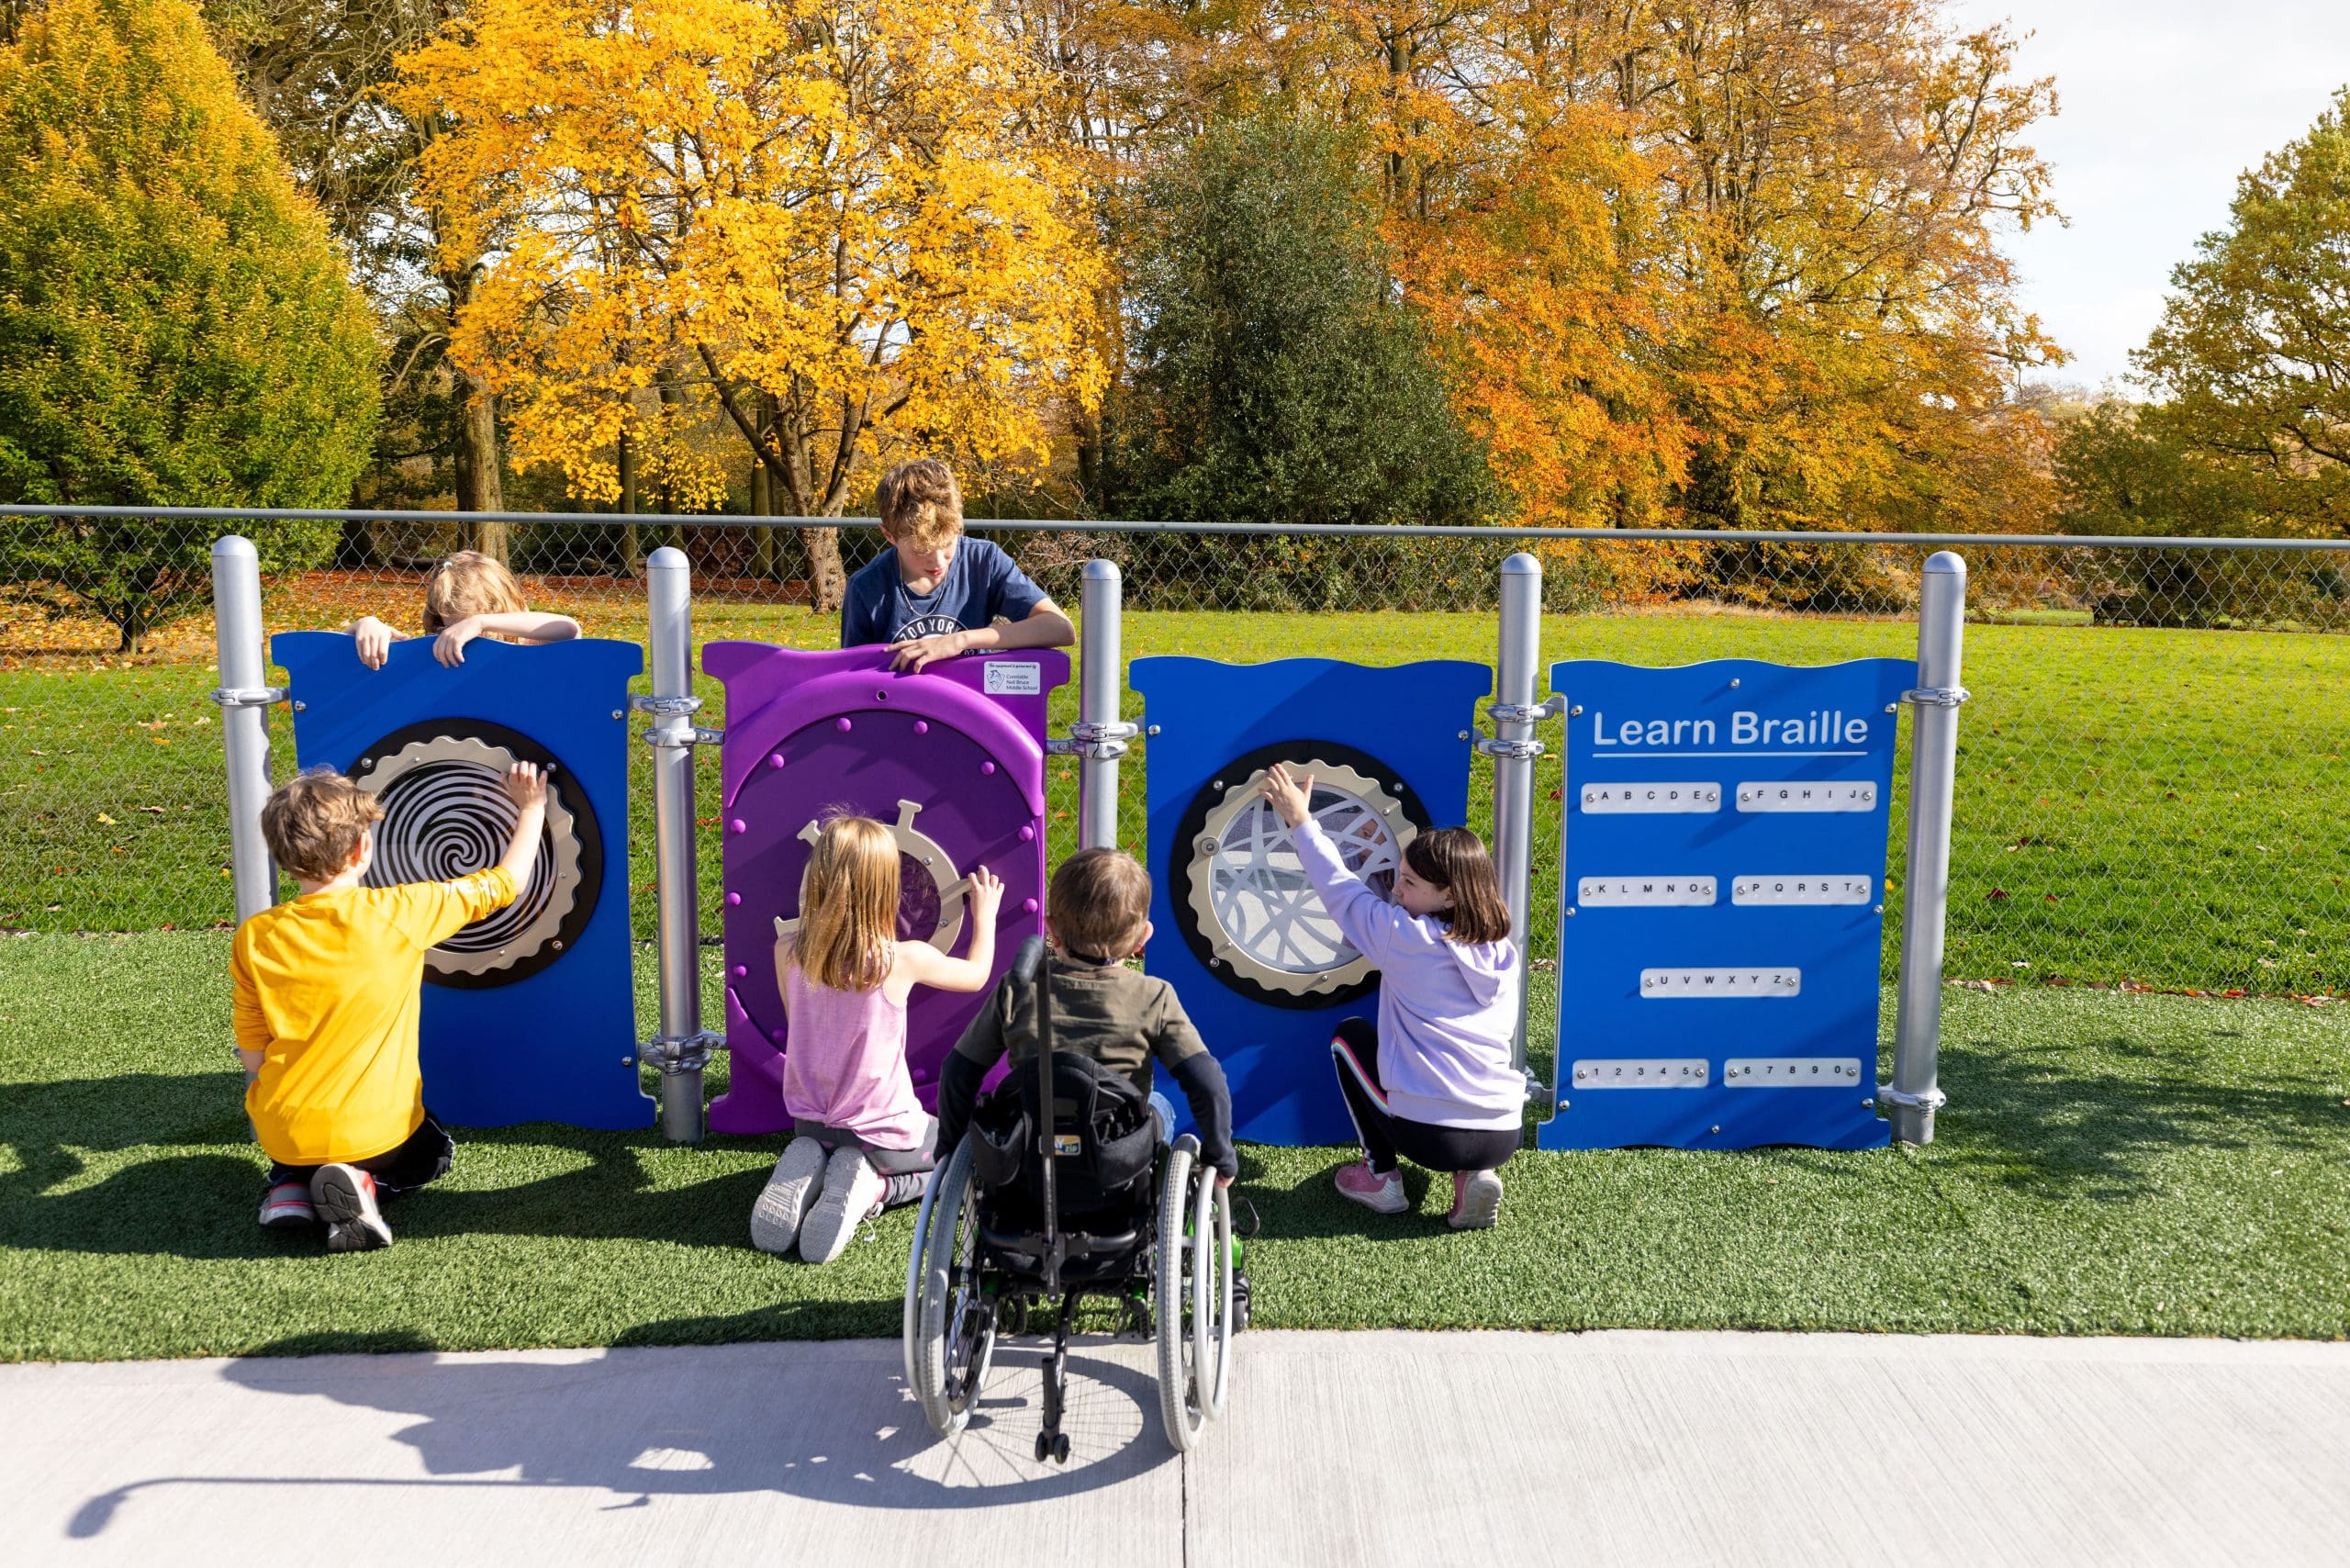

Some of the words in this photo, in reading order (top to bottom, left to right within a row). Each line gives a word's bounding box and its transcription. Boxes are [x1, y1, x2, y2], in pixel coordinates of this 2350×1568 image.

[1594, 711, 1716, 745] Learn
[1731, 710, 1868, 745] Braille
[1600, 790, 1609, 801] A
[1624, 790, 1632, 801] B
[1646, 790, 1656, 801] C
[1670, 790, 1678, 801] D
[1693, 790, 1701, 800] E
[1756, 790, 1764, 800] F
[1779, 790, 1788, 800] G
[1802, 790, 1811, 799] H
[1850, 790, 1857, 799] J
[1598, 884, 1606, 893] K
[1621, 884, 1628, 893] L
[1643, 883, 1653, 893] M
[1666, 883, 1675, 893] N
[1689, 883, 1698, 893] O
[1751, 883, 1761, 892] P
[1774, 882, 1784, 892] Q
[1797, 882, 1807, 892] R
[1820, 882, 1829, 892] S
[1844, 882, 1852, 891] T
[1660, 976, 1669, 985] U
[1683, 976, 1691, 985] V
[1704, 975, 1716, 984] W
[1728, 975, 1736, 984] X
[1751, 975, 1760, 984] Y
[1773, 975, 1782, 984] Z
[1615, 1067, 1622, 1076] 2
[1638, 1067, 1645, 1076] 3
[1660, 1067, 1667, 1075] 4
[1682, 1067, 1690, 1076] 5
[1743, 1066, 1751, 1075] 6
[1766, 1066, 1774, 1074] 7
[1788, 1065, 1796, 1074] 8
[1811, 1065, 1818, 1074] 9
[1834, 1065, 1841, 1074] 0
